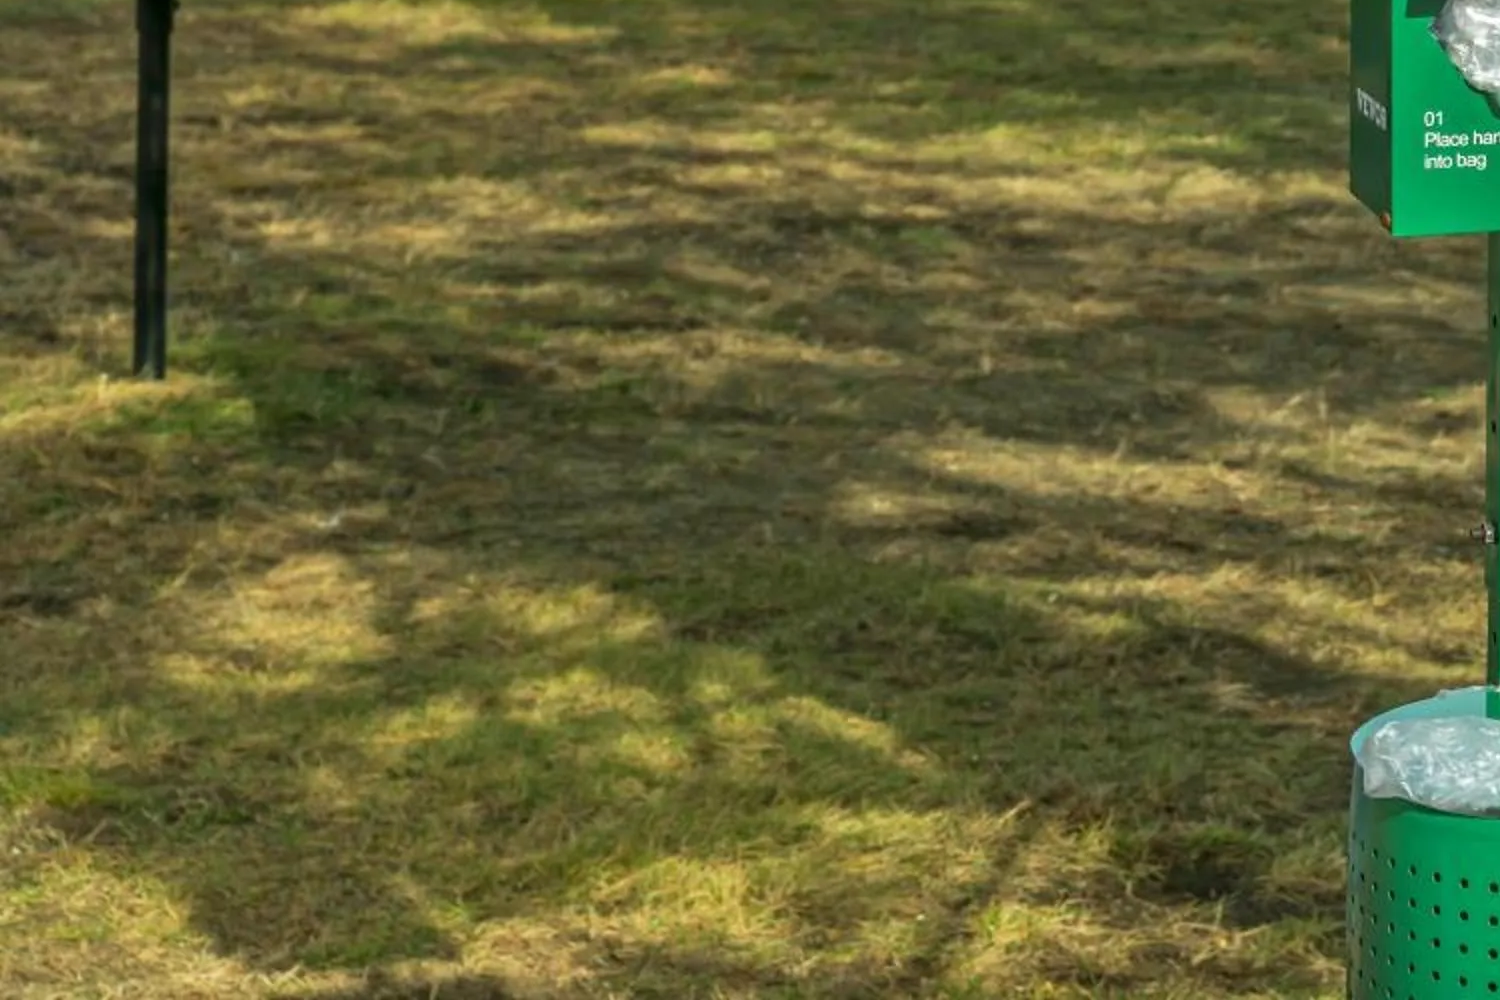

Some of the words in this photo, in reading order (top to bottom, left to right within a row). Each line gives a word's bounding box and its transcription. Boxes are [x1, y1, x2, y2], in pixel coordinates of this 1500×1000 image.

[1423, 110, 1443, 127] 01
[1424, 131, 1469, 148] Place
[1423, 153, 1453, 169] into
[1456, 151, 1487, 171] bag
